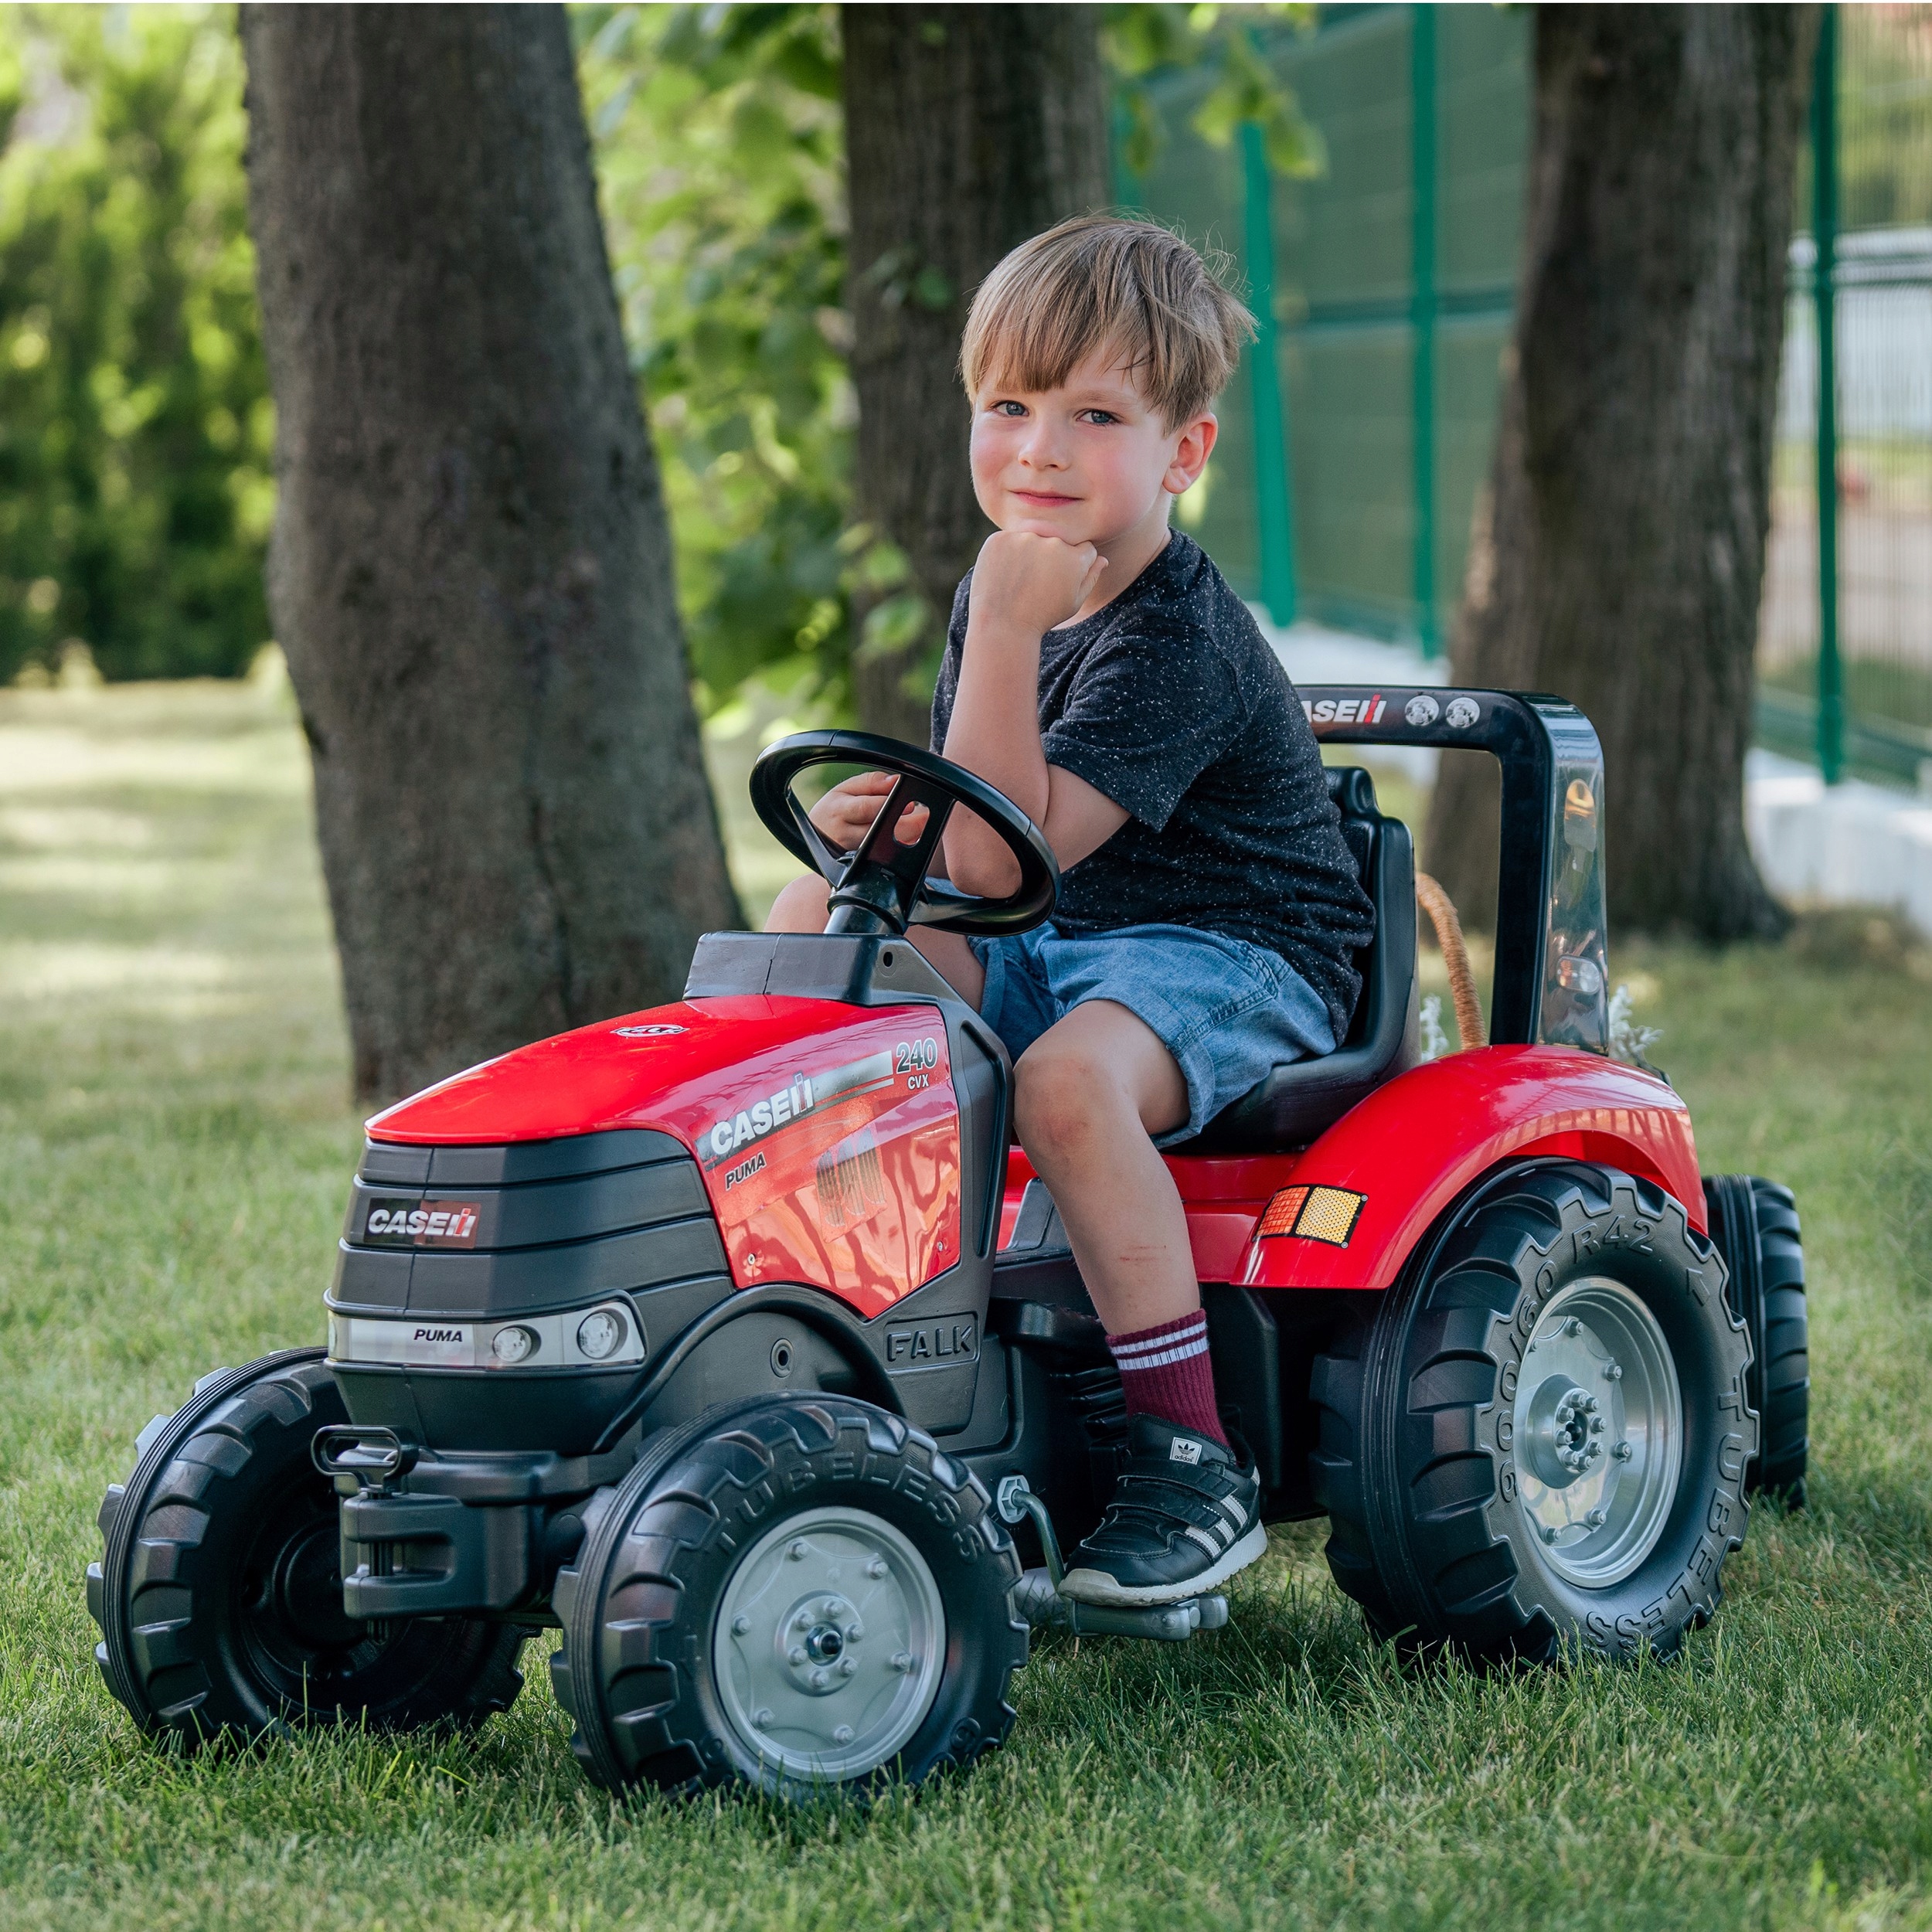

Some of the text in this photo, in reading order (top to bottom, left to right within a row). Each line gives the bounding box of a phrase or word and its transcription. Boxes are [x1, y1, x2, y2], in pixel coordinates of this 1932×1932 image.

[896, 1037, 938, 1074] 240
[907, 1073, 930, 1090] CVX
[725, 1151, 767, 1191] PUMA
[1572, 1215, 1657, 1264] R42
[413, 1328, 462, 1342] PUMA
[888, 1325, 972, 1362] FALK
[702, 1451, 985, 1563] TUBELESS
[1587, 1376, 1743, 1650] TUBELESS
